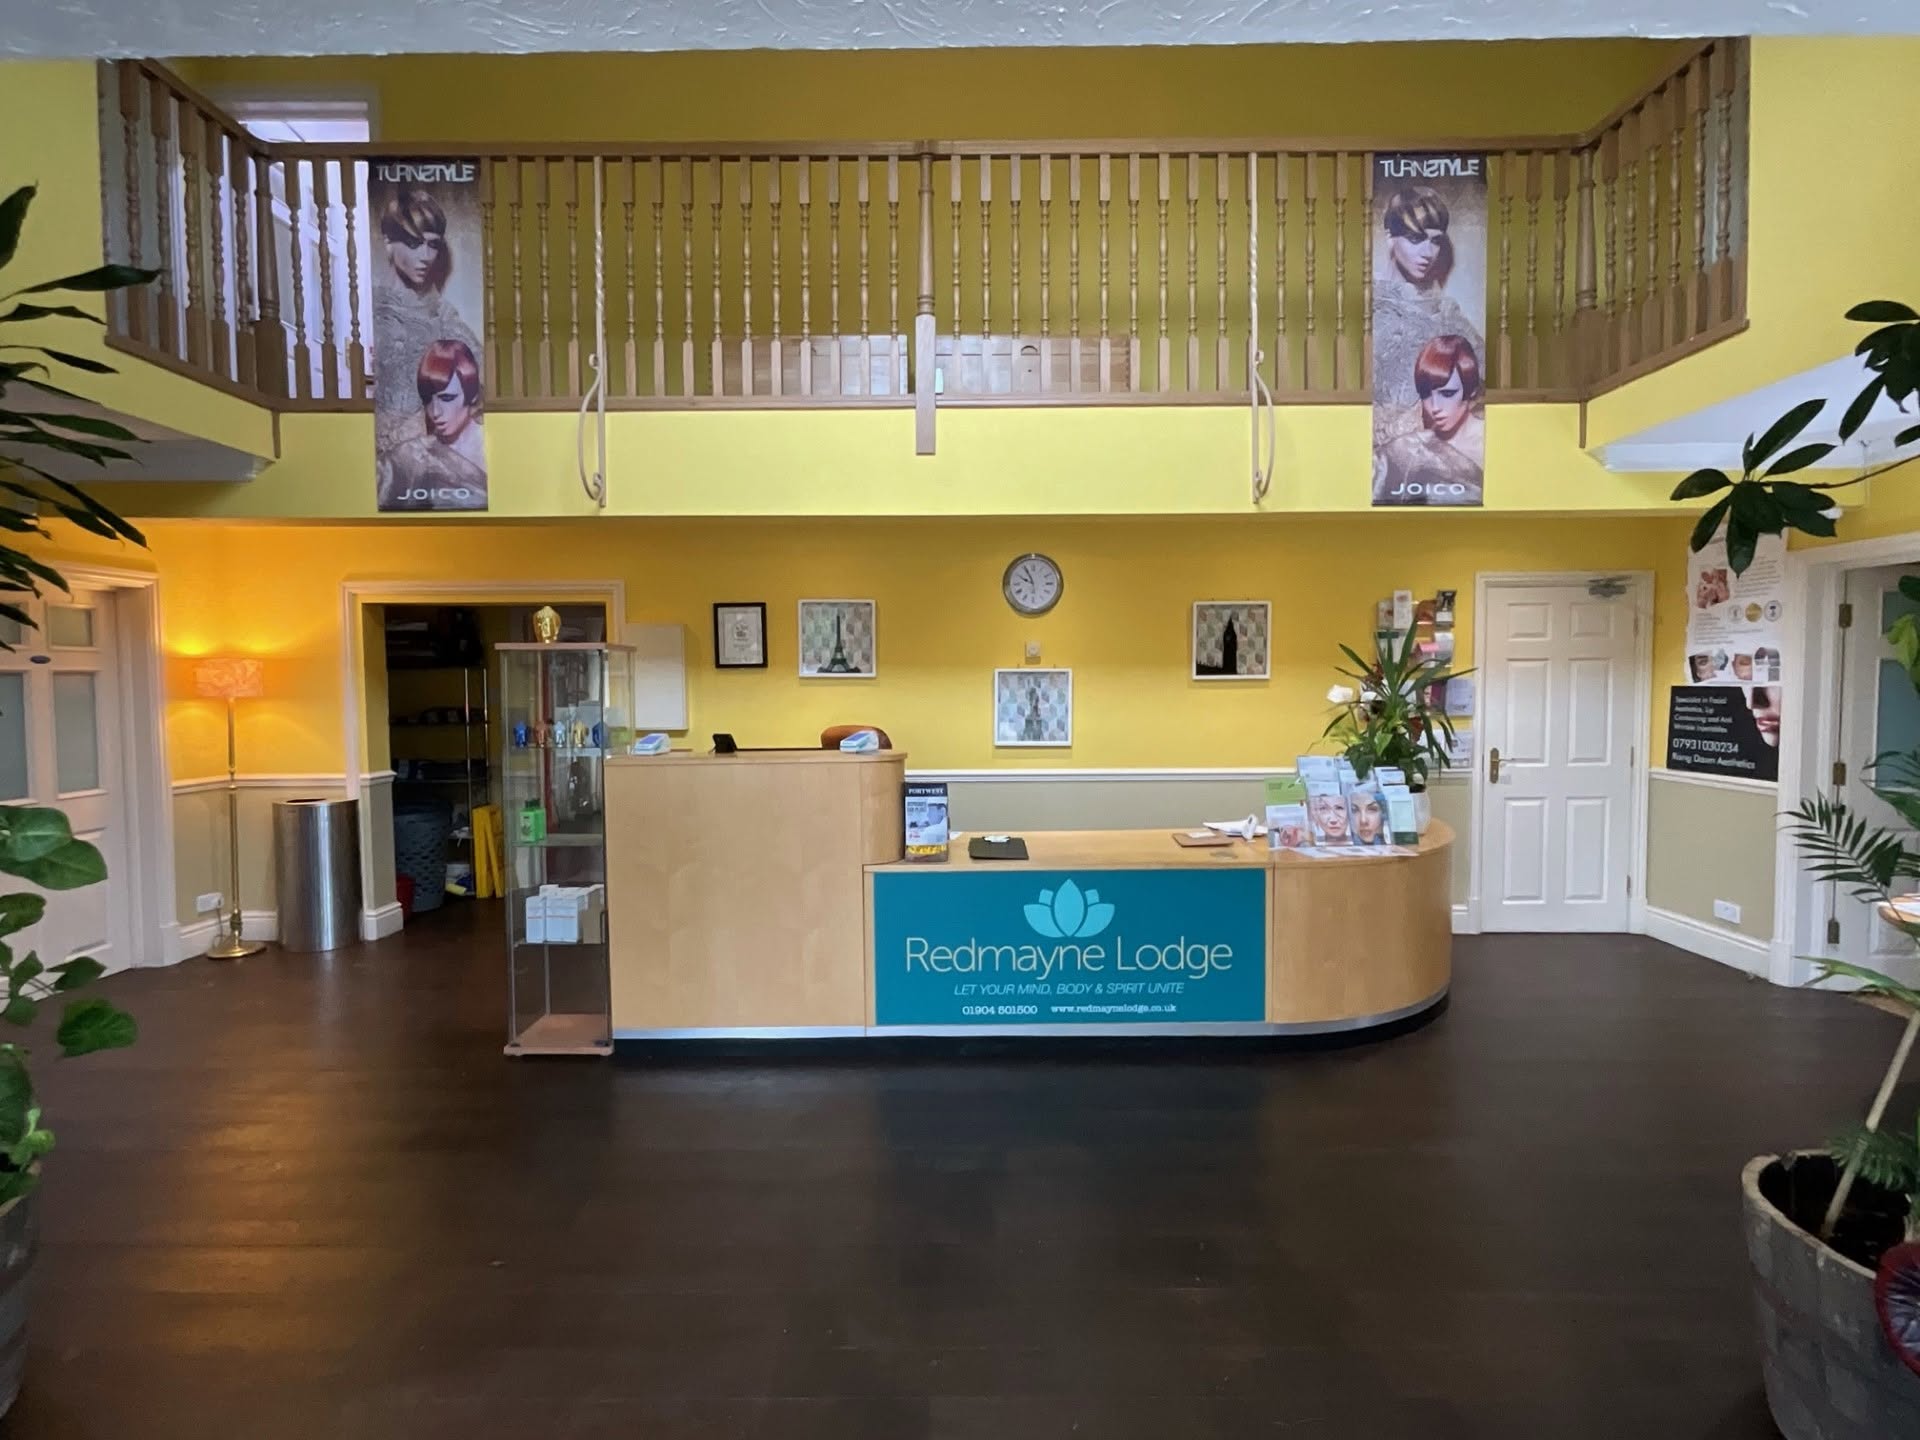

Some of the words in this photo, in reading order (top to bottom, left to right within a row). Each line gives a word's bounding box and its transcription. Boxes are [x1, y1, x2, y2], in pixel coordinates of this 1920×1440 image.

[376, 164, 475, 182] TURNSTYLE
[1379, 158, 1479, 177] TURNSTYLE
[397, 488, 470, 500] JOICO
[1391, 483, 1465, 495] JOICO
[1672, 738, 1739, 753] 07931030234
[905, 937, 1106, 980] Redmayne
[1117, 936, 1233, 979] Lodge
[953, 984, 976, 995] LET
[979, 984, 1015, 995] YOUR
[1056, 983, 1094, 995] BODY
[1094, 983, 1104, 994] &
[1106, 982, 1146, 994] SPIRIT
[1148, 982, 1185, 994] UNITE
[962, 1005, 995, 1016] 01904
